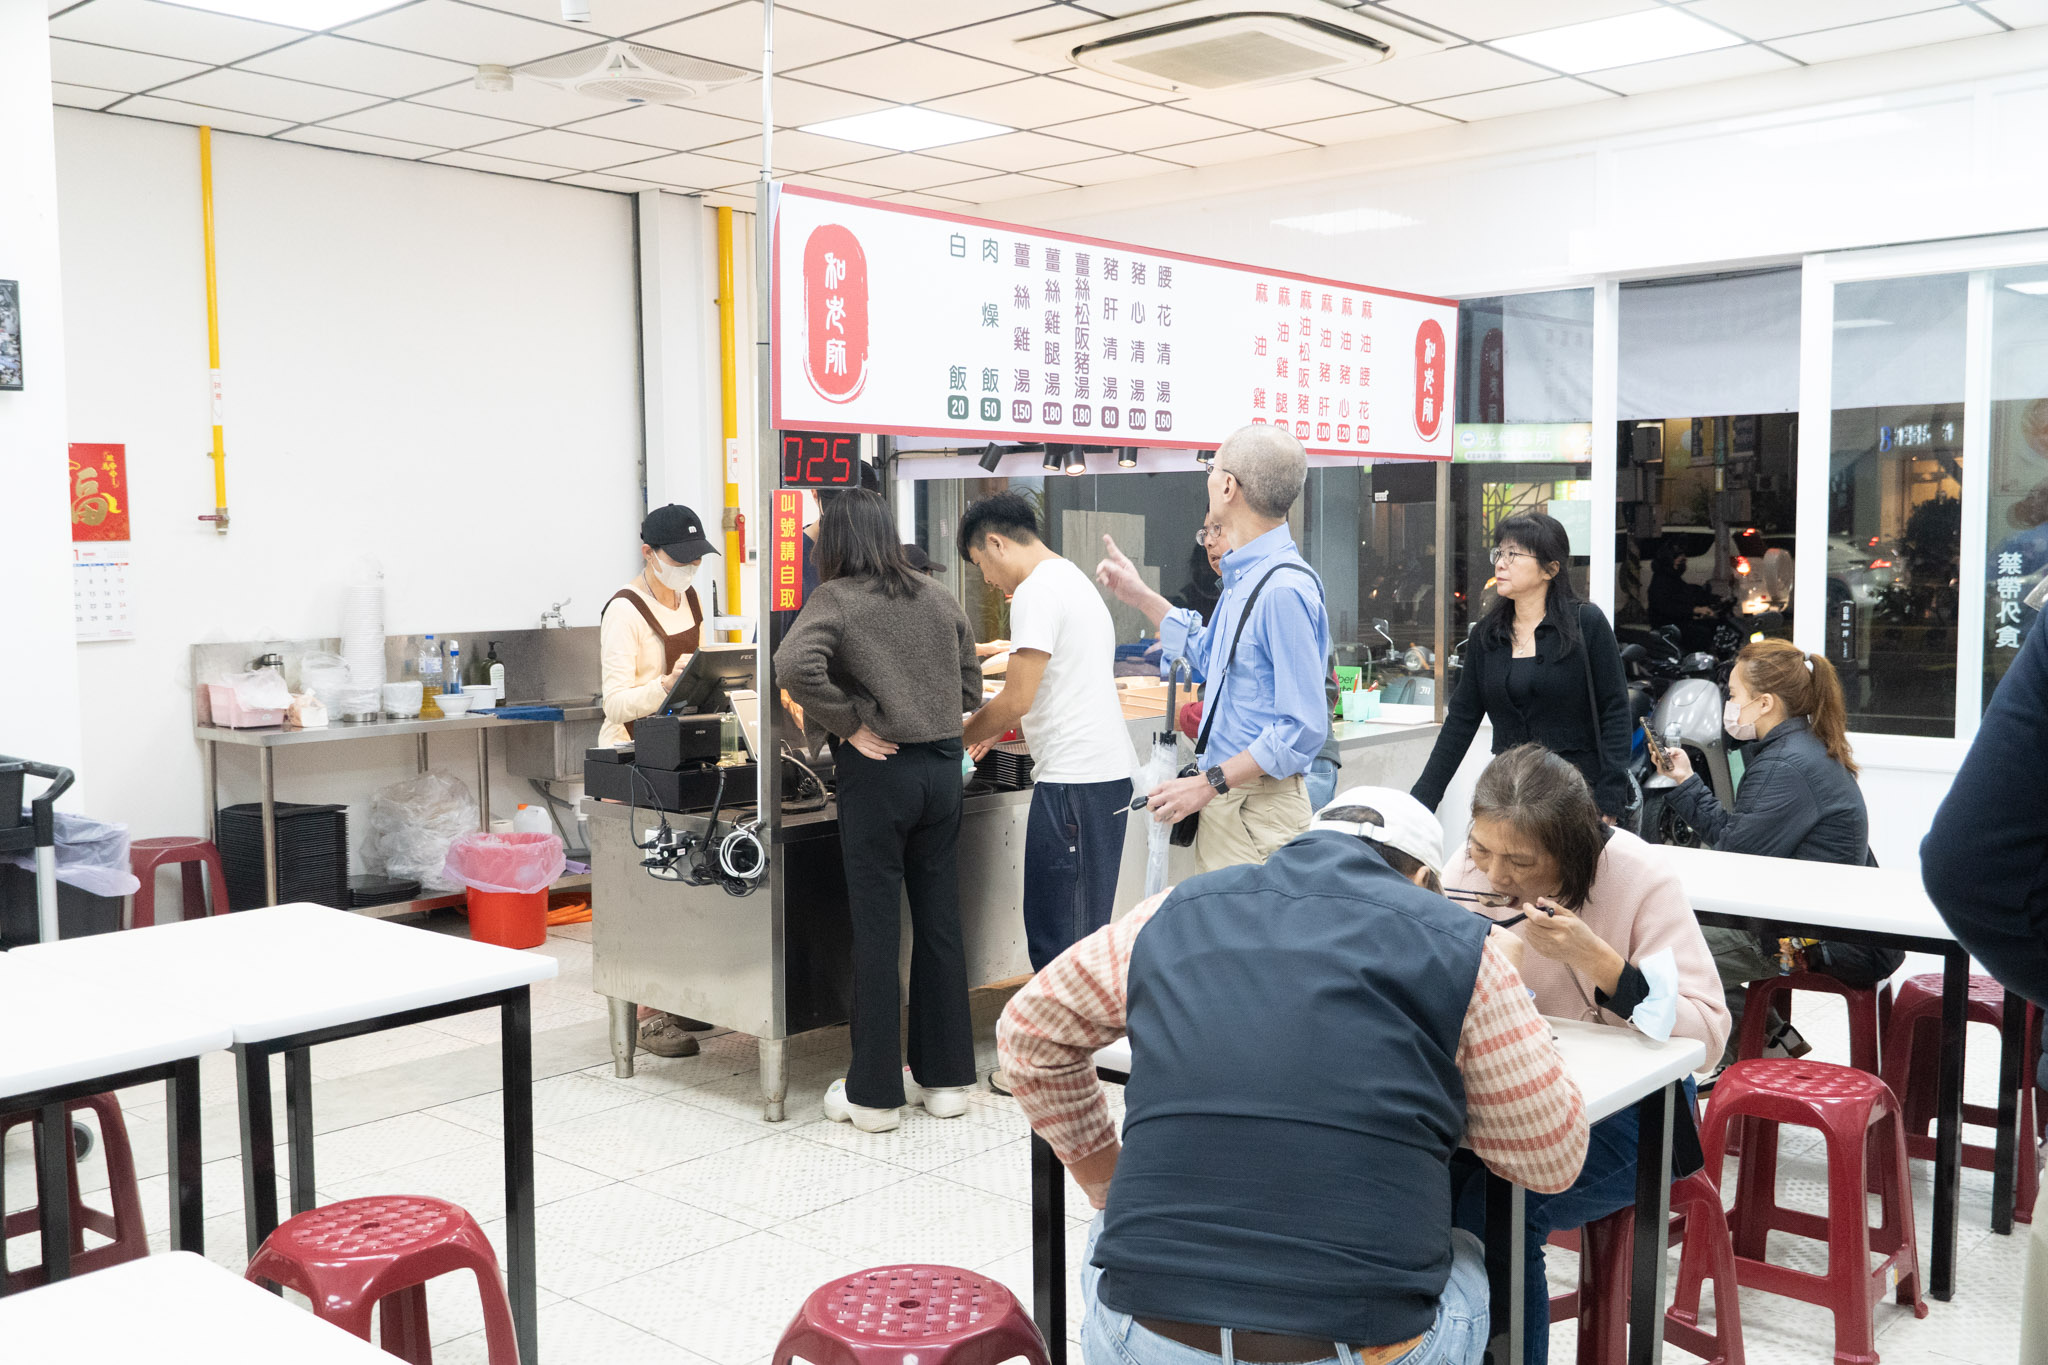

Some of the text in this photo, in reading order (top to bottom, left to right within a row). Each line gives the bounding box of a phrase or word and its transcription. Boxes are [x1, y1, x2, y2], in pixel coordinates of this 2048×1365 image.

[949, 232, 967, 416] 白飯 20
[981, 238, 1000, 417] 肉燥飯 50
[1013, 242, 1031, 419] 薑絲雞湯 150
[1044, 247, 1061, 421] 薑絲雞腿湯 180
[1074, 252, 1090, 424] 薑絲松阪豬湯 180
[1103, 256, 1119, 425] 豬肝清湯 80
[1130, 260, 1146, 427] 豬心清湯 100
[1156, 265, 1172, 428] 腰花清湯 160
[1253, 283, 1268, 409] 麻油雞
[1275, 286, 1290, 414] 麻油雞腿
[1297, 290, 1312, 438] 麻油松阪豬 200
[1317, 294, 1333, 439] 麻油豬肝 100
[1338, 297, 1353, 440] 麻油豬心 120
[1358, 300, 1372, 441] 麻油腰花 180
[780, 494, 796, 608] 叫號請自取
[1337, 673, 1354, 683] ber
